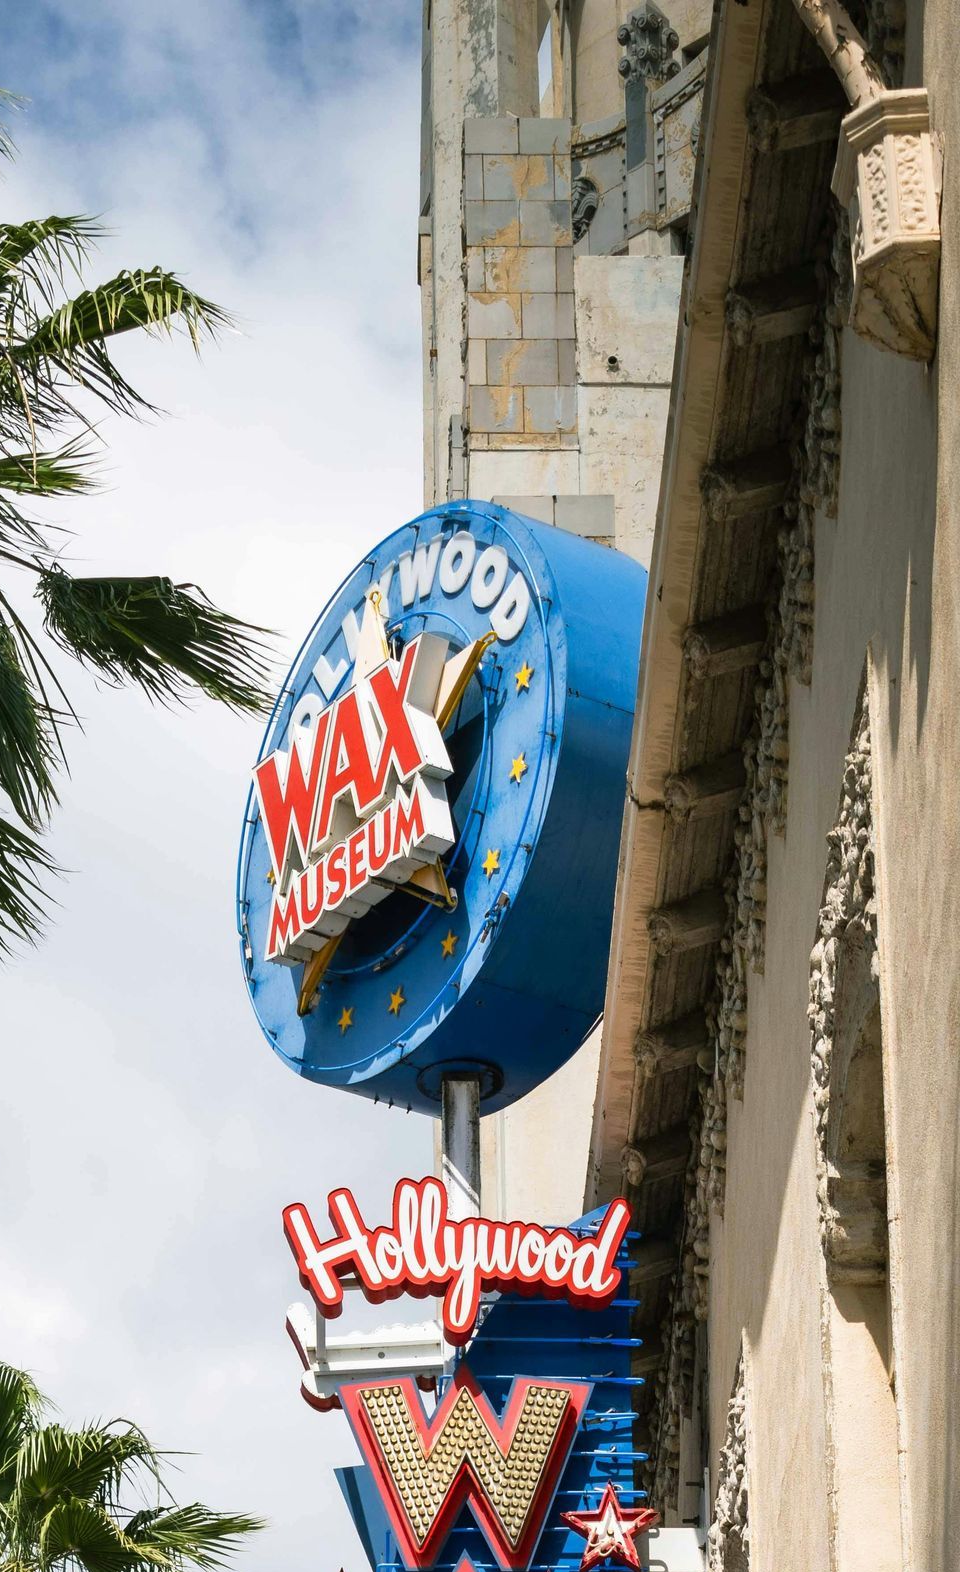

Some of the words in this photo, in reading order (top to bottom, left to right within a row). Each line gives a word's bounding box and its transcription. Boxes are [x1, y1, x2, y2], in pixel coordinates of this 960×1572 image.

[253, 641, 425, 875] WAX
[266, 789, 426, 960] MUSEUM
[287, 1179, 628, 1331] Hollywood
